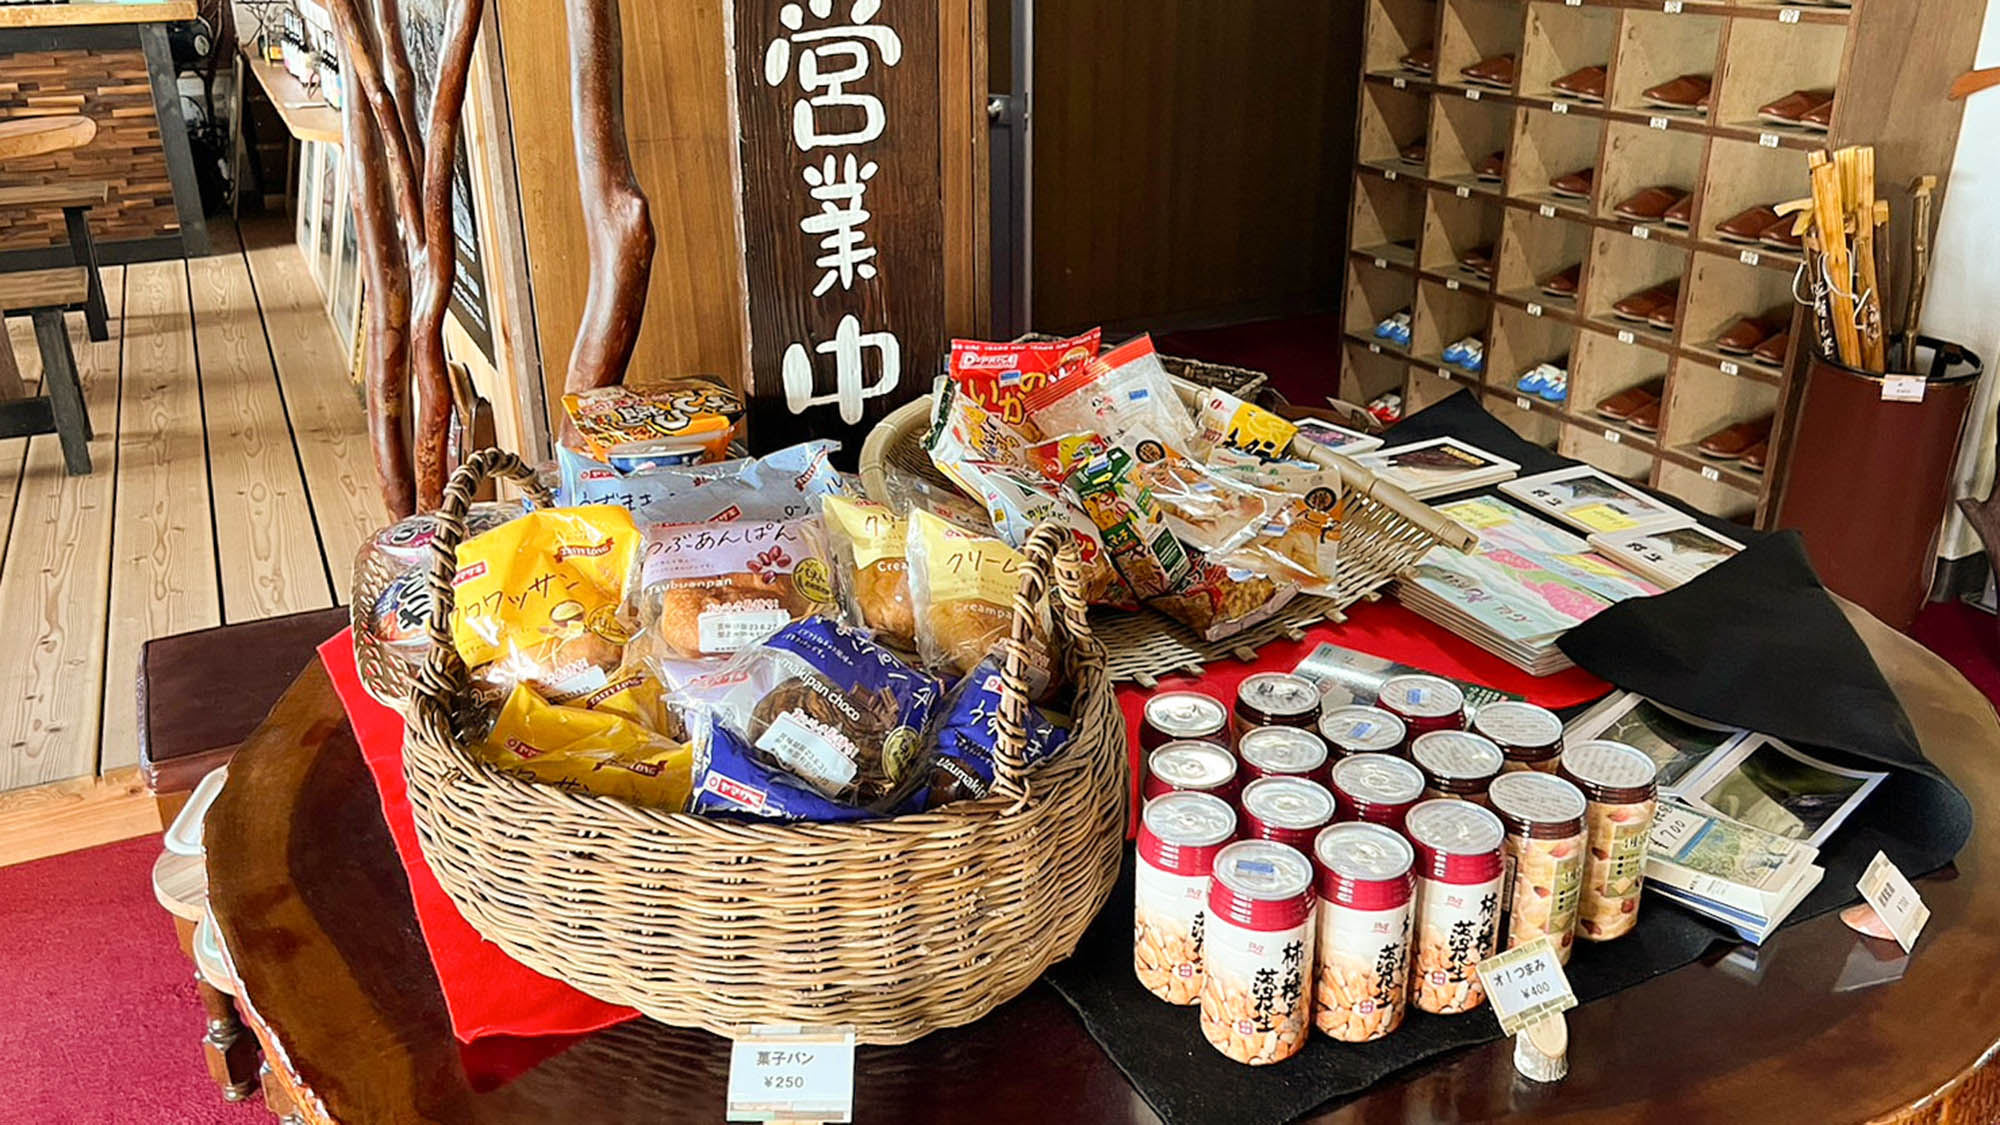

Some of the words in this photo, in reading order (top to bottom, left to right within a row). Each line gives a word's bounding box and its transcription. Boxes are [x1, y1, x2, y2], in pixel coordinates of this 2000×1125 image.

[765, 0, 902, 425] 営業中
[647, 523, 797, 556] つぶあんぱん
[946, 550, 1018, 573] クリーム
[828, 691, 862, 723] choco
[1242, 968, 1279, 1032] 落花生
[1521, 981, 1551, 998] ¥400
[757, 1051, 815, 1066] 菓子パン
[764, 1076, 805, 1088] ¥250
